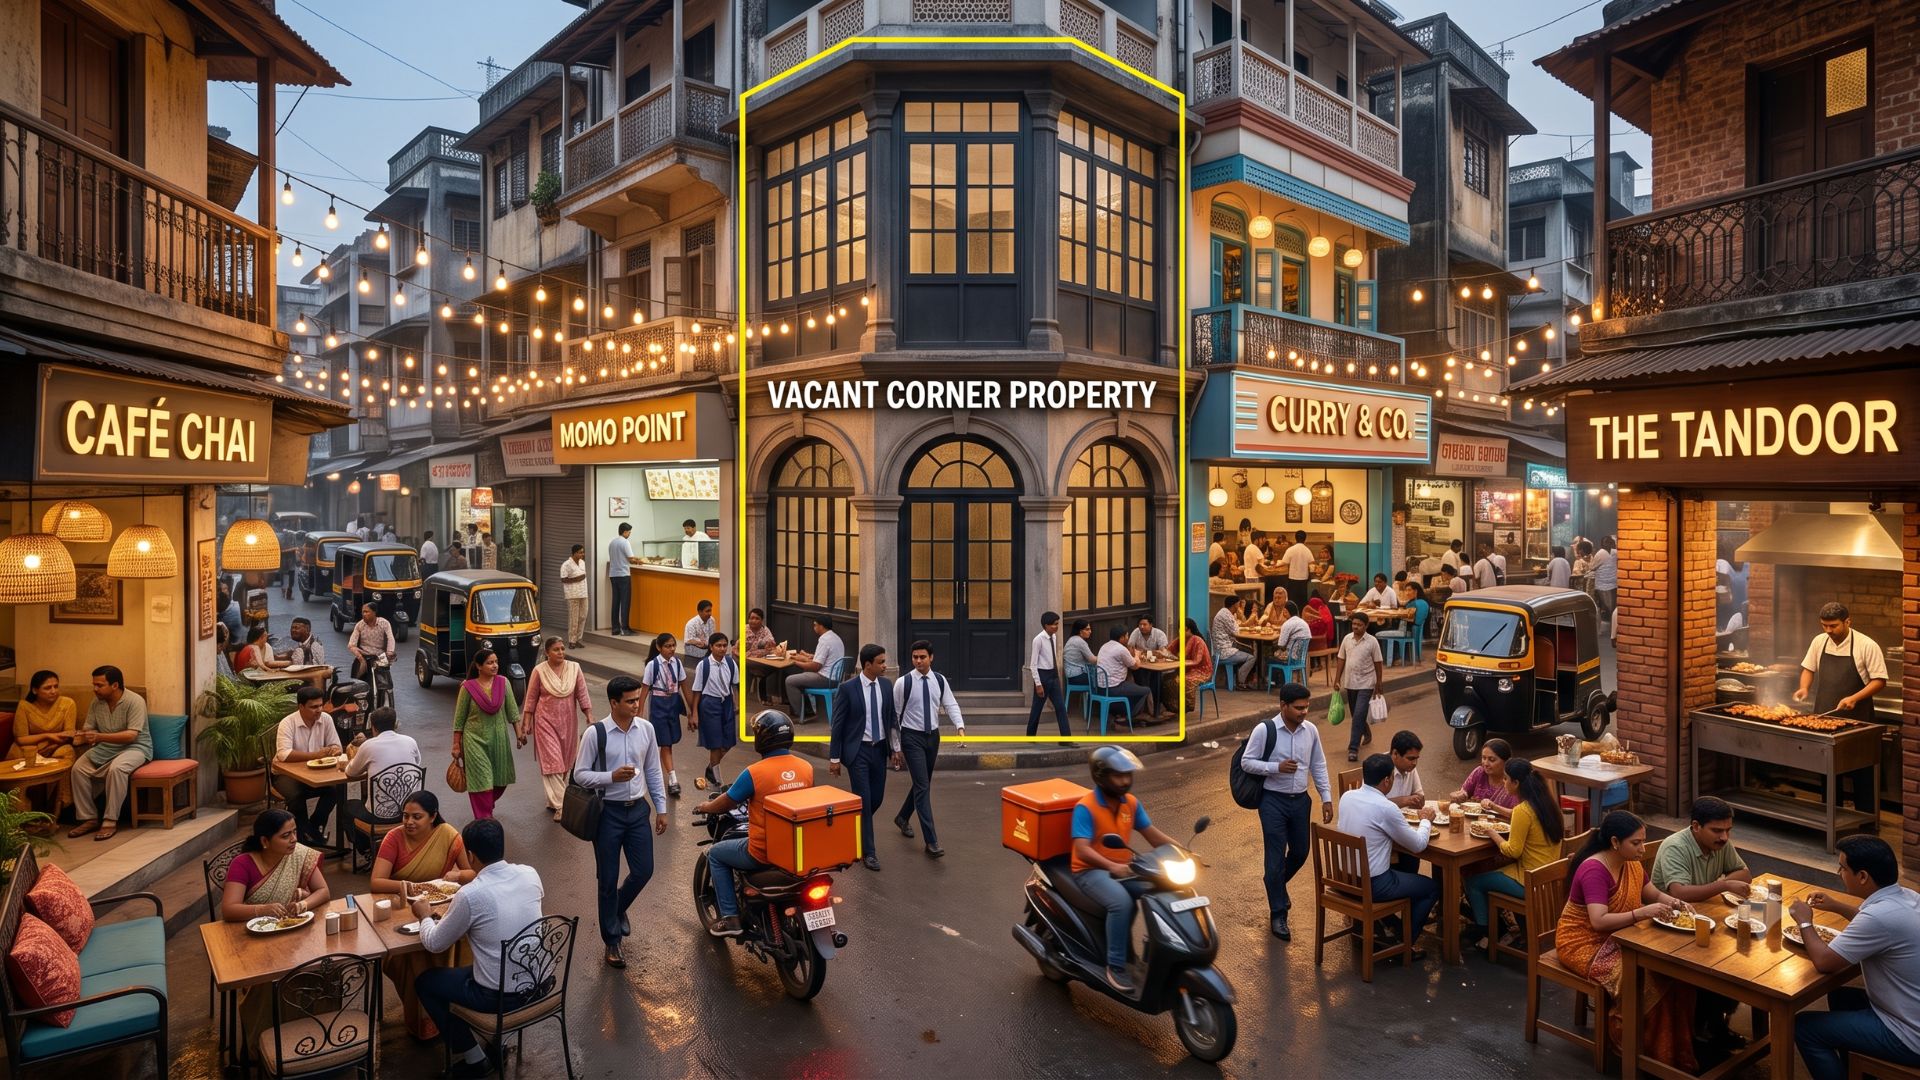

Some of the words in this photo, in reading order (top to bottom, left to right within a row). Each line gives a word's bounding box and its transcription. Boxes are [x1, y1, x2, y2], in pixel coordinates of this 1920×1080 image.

[66, 397, 170, 458] CAFÉ
[181, 413, 256, 463] CHAI
[560, 418, 618, 449] MOMO
[622, 410, 687, 444] POINT
[1269, 395, 1352, 436] CURRY
[1358, 403, 1374, 438] &
[1379, 406, 1413, 440] CO.
[1589, 414, 1660, 460] THE
[1671, 400, 1899, 458] TANDOOR
